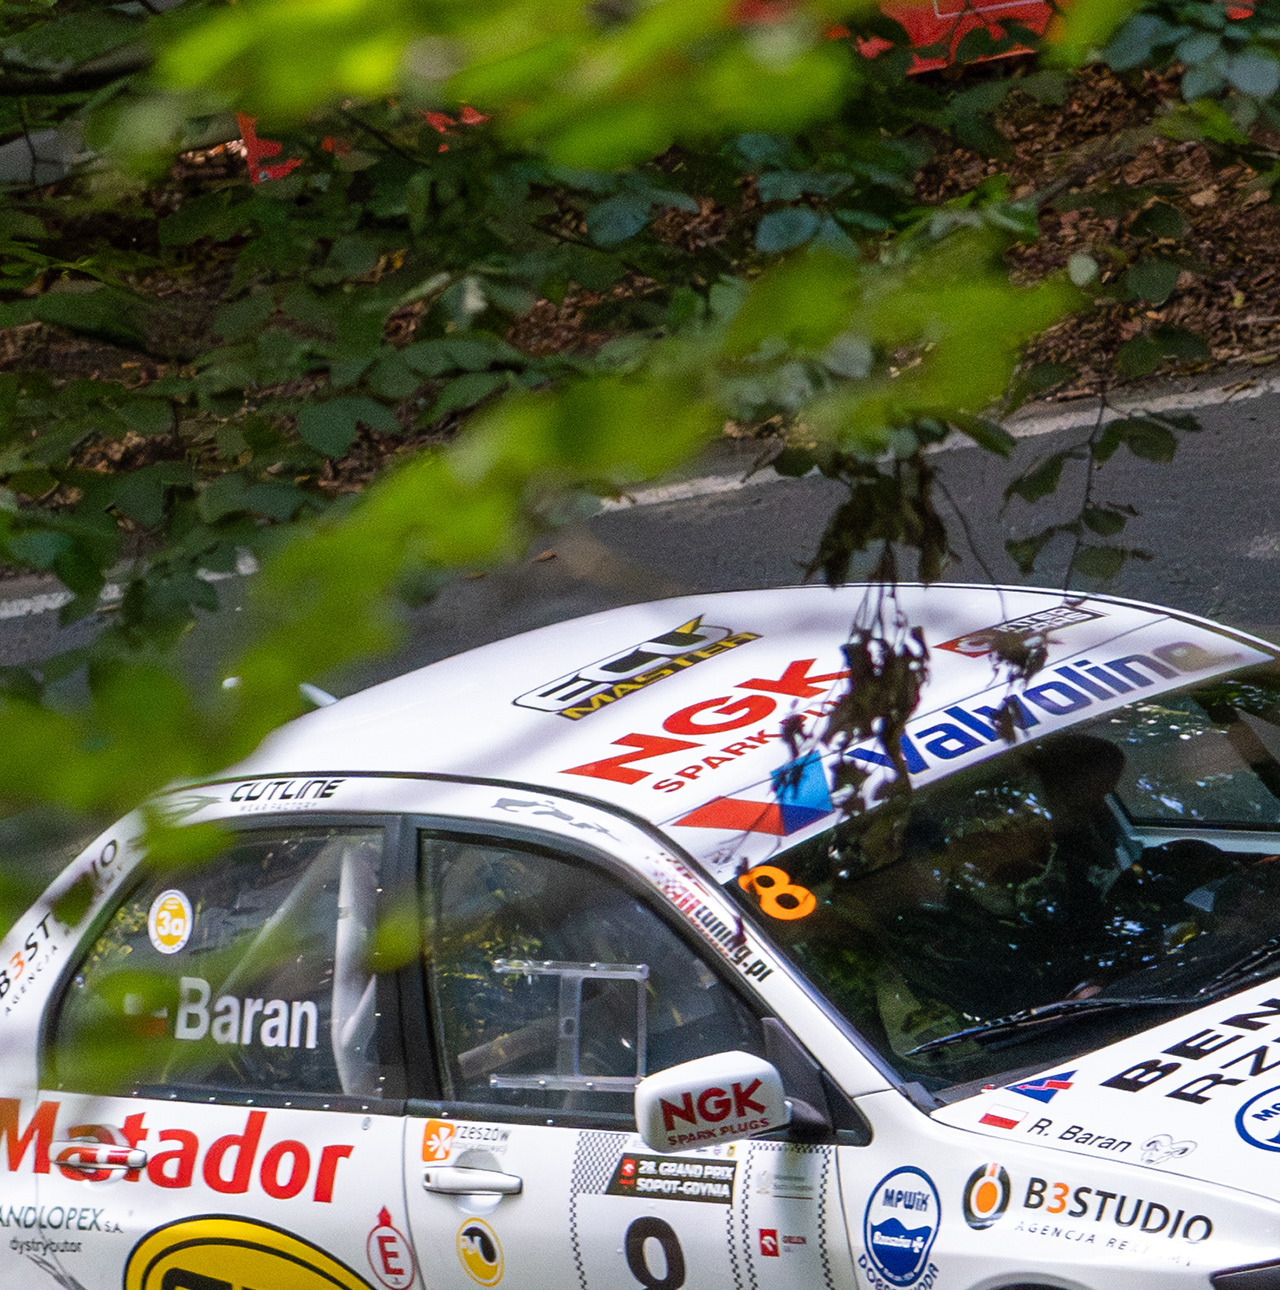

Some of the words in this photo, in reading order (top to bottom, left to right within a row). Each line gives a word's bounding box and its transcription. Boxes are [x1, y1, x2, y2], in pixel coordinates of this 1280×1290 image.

[558, 632, 762, 720] MASTER
[557, 658, 853, 785] NGK
[652, 729, 783, 793] SPARK
[230, 779, 347, 802] CUTLINE
[738, 865, 816, 920] 8
[156, 910, 186, 936] 3a
[175, 976, 318, 1049] Baran
[659, 1078, 767, 1131] NGK
[668, 1130, 718, 1146] SPARK
[720, 1118, 770, 1135] PLUGS
[1027, 1118, 1049, 1136] R.
[1059, 1125, 1132, 1153] Baran
[1015, 1221, 1095, 1244] AGENCJA
[1023, 1177, 1214, 1243] B3STUDIO
[377, 1236, 404, 1275] E
